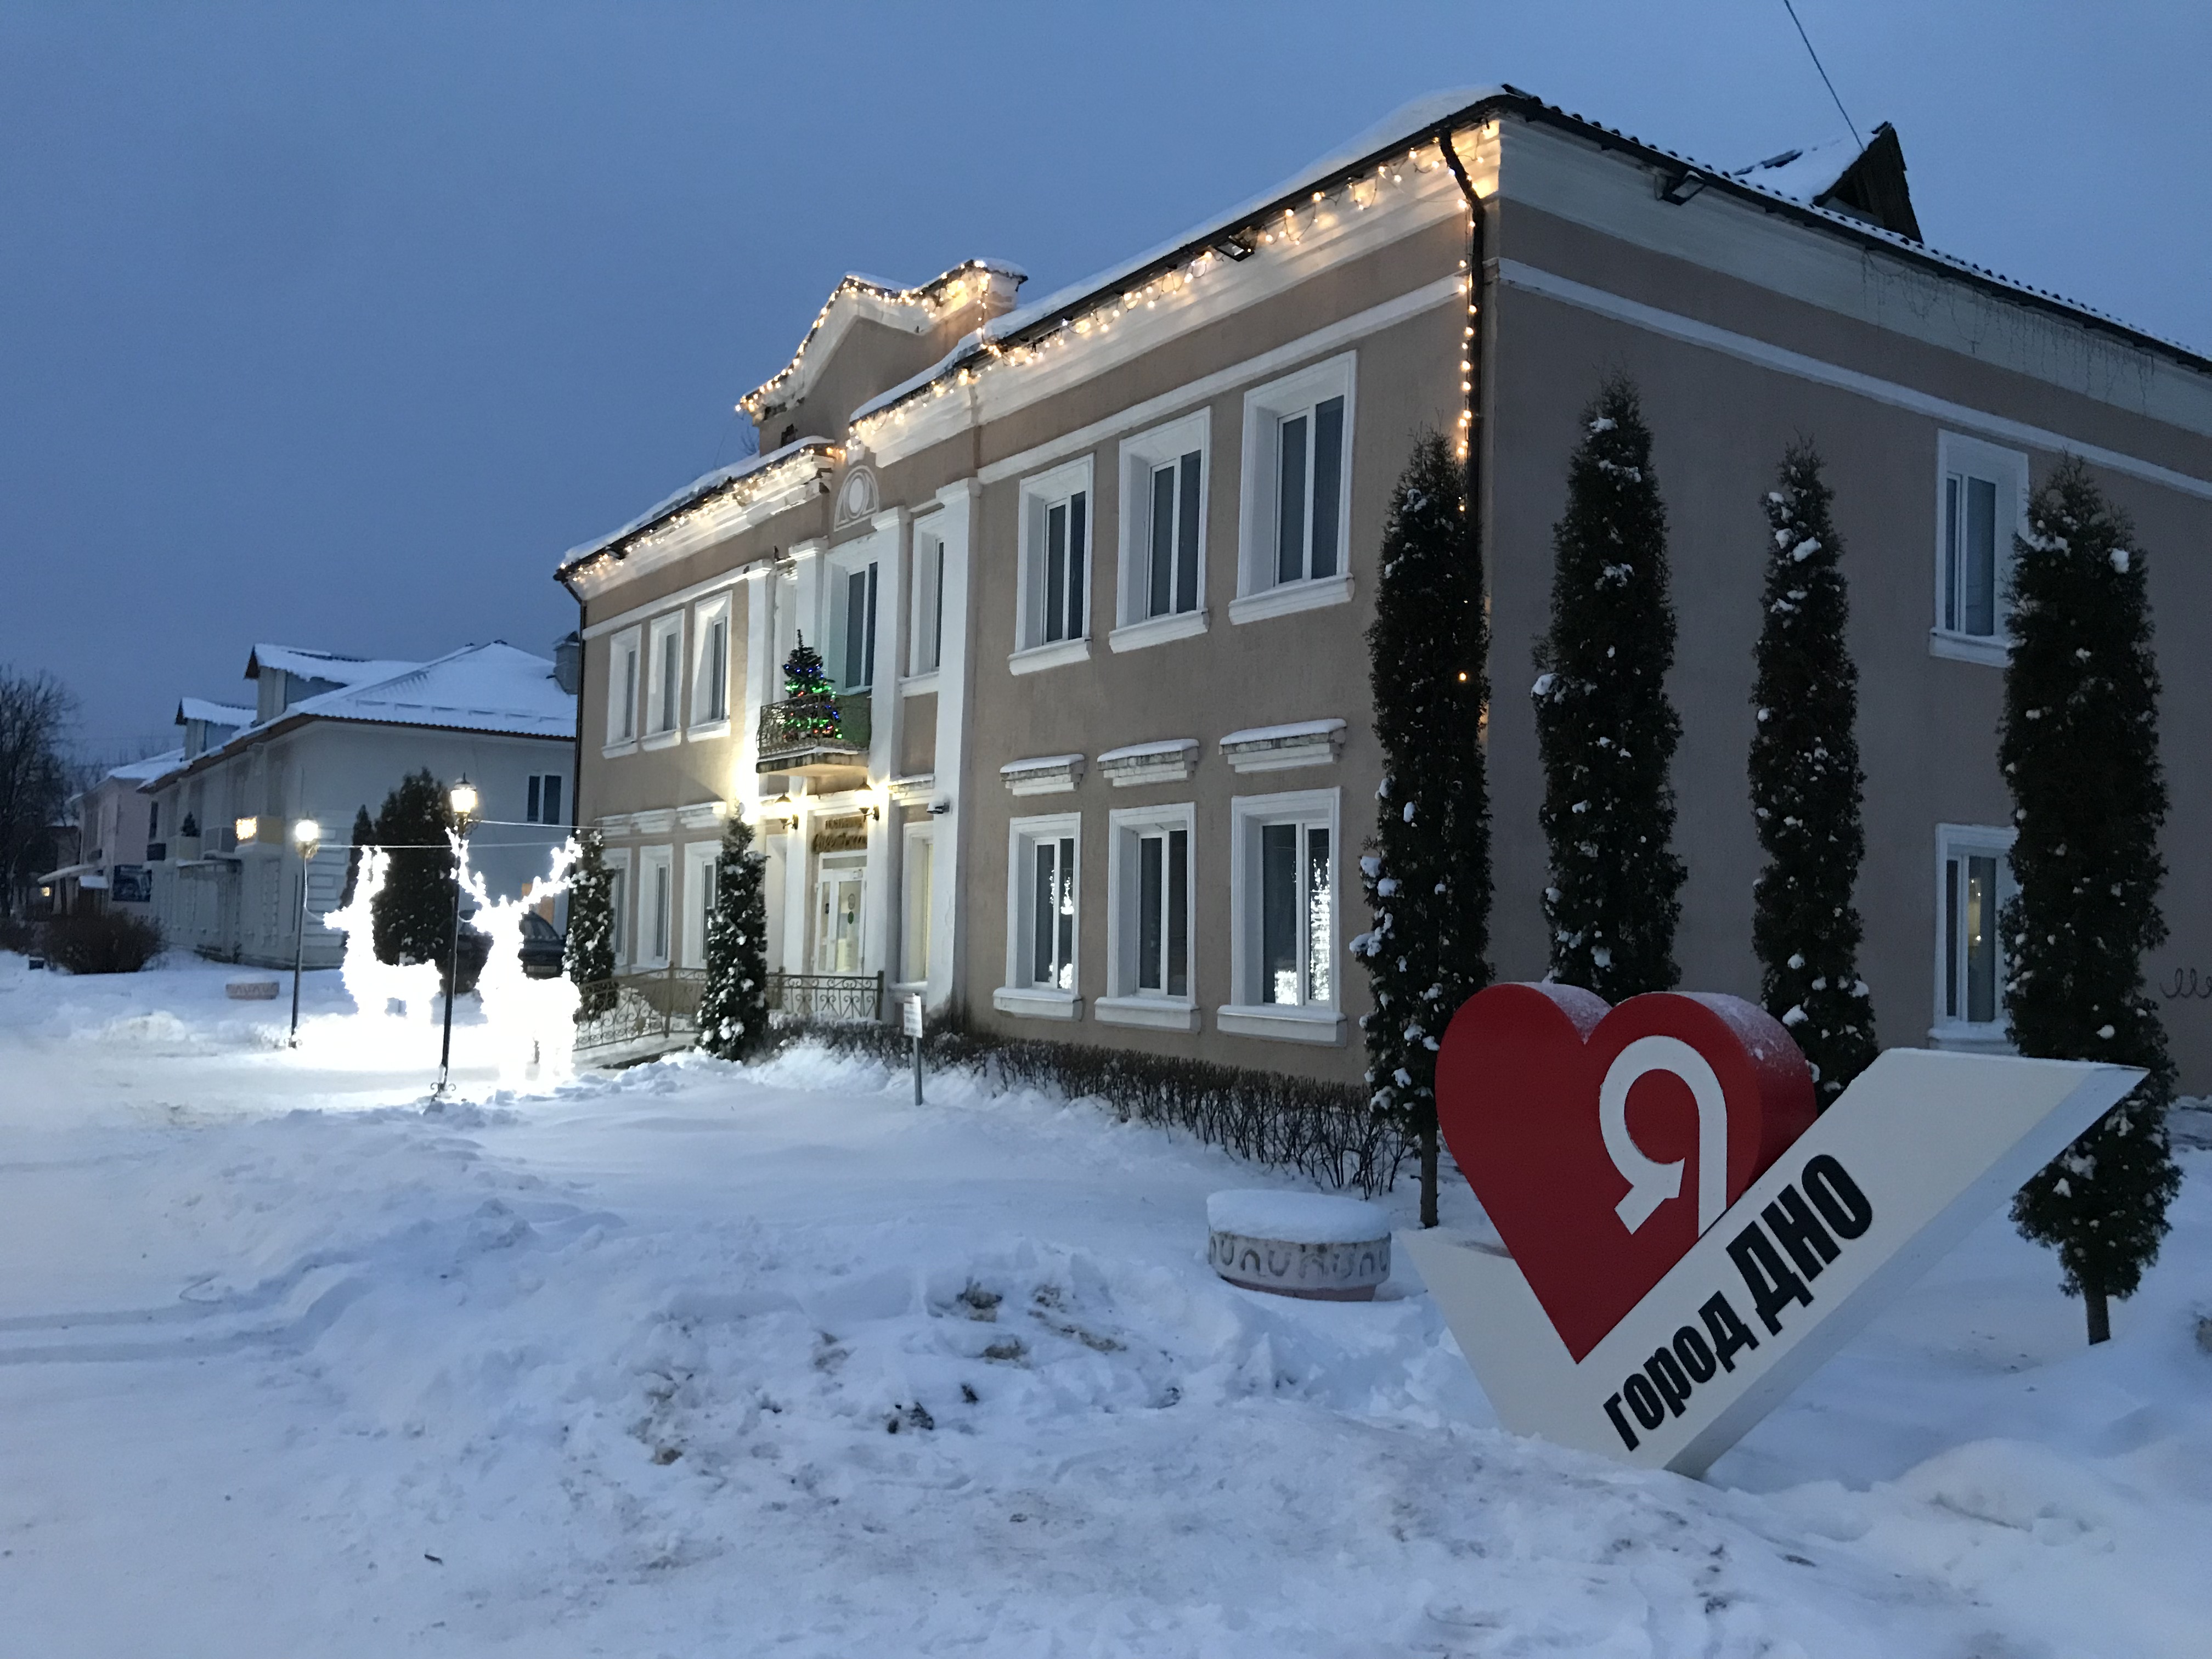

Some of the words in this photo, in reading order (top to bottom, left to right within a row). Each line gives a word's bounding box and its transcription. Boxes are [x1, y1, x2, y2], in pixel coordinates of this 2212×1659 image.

[1599, 1035, 1728, 1238] Я
[1603, 1290, 1759, 1452] город
[1725, 1154, 1872, 1336] ДНО
